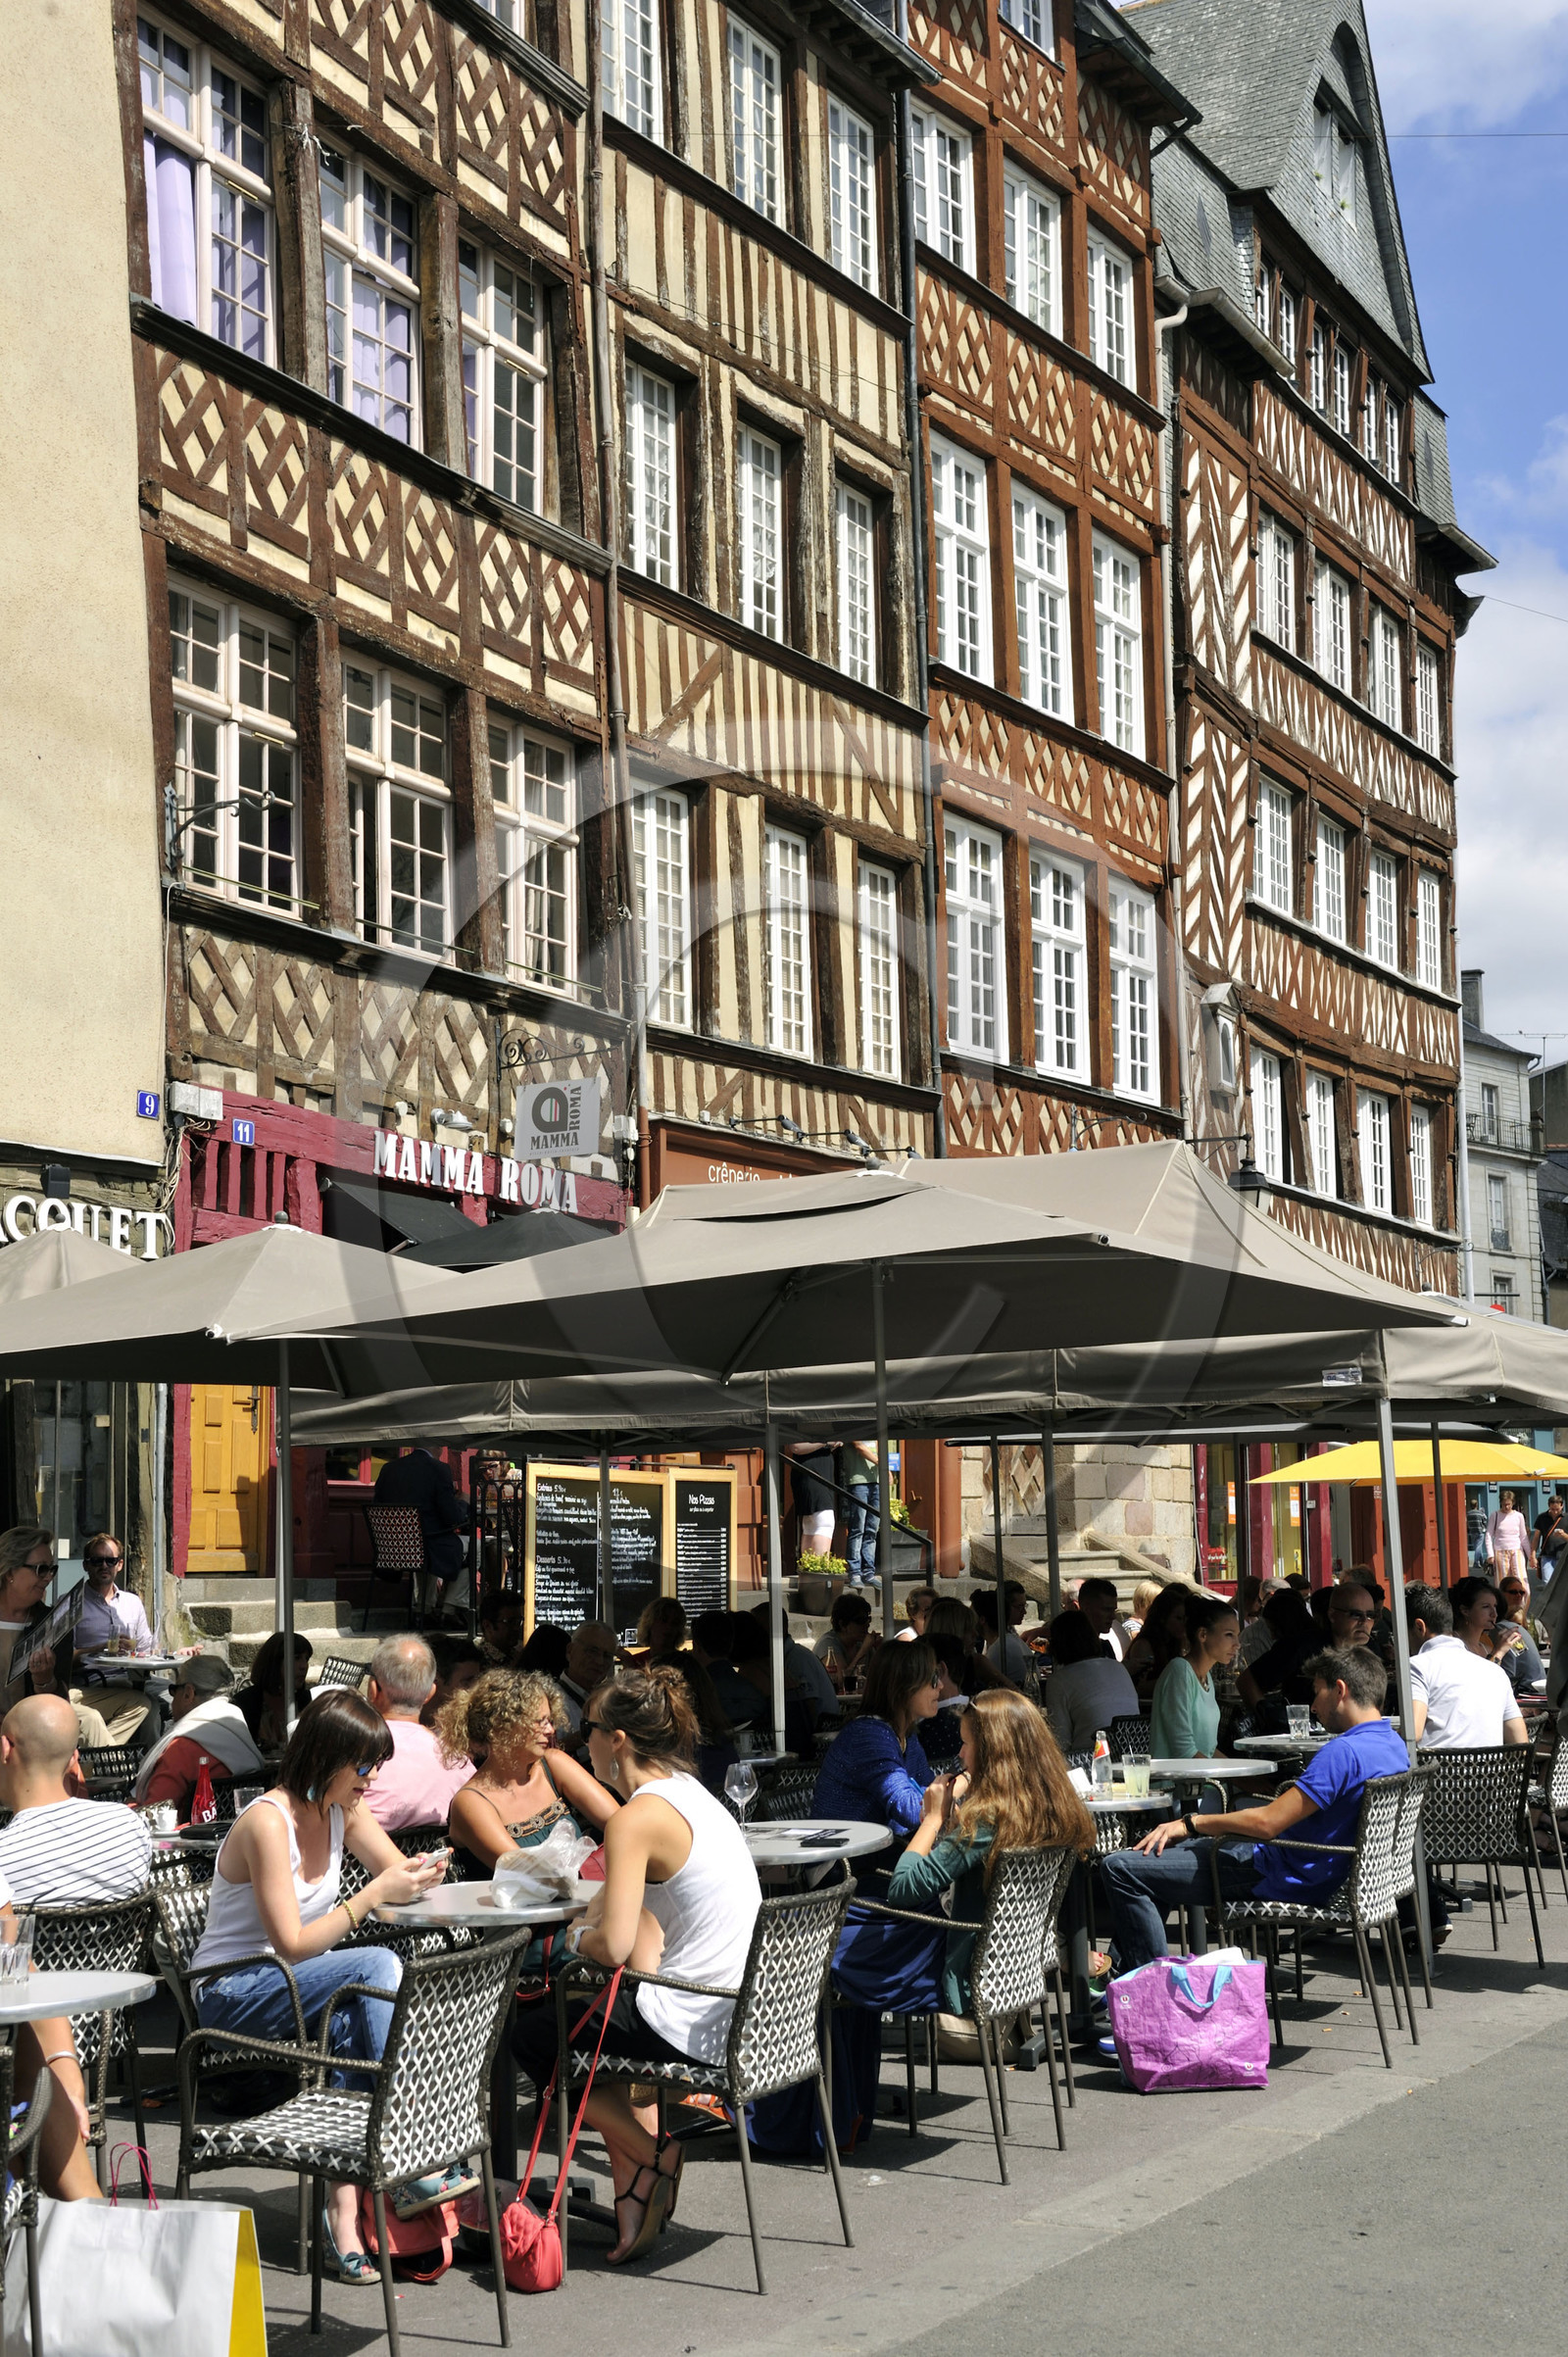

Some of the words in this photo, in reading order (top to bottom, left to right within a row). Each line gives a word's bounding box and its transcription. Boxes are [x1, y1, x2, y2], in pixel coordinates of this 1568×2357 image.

[145, 1095, 155, 1115] 9
[568, 1085, 582, 1131] ROMA
[237, 1122, 250, 1143] 11
[530, 1132, 579, 1151] MAMMA
[372, 1130, 485, 1196] MAMMA
[499, 1156, 579, 1214] ROMA
[688, 1494, 699, 1505] Nos
[699, 1494, 715, 1505] Pizzas
[536, 1554, 556, 1564] Desserts
